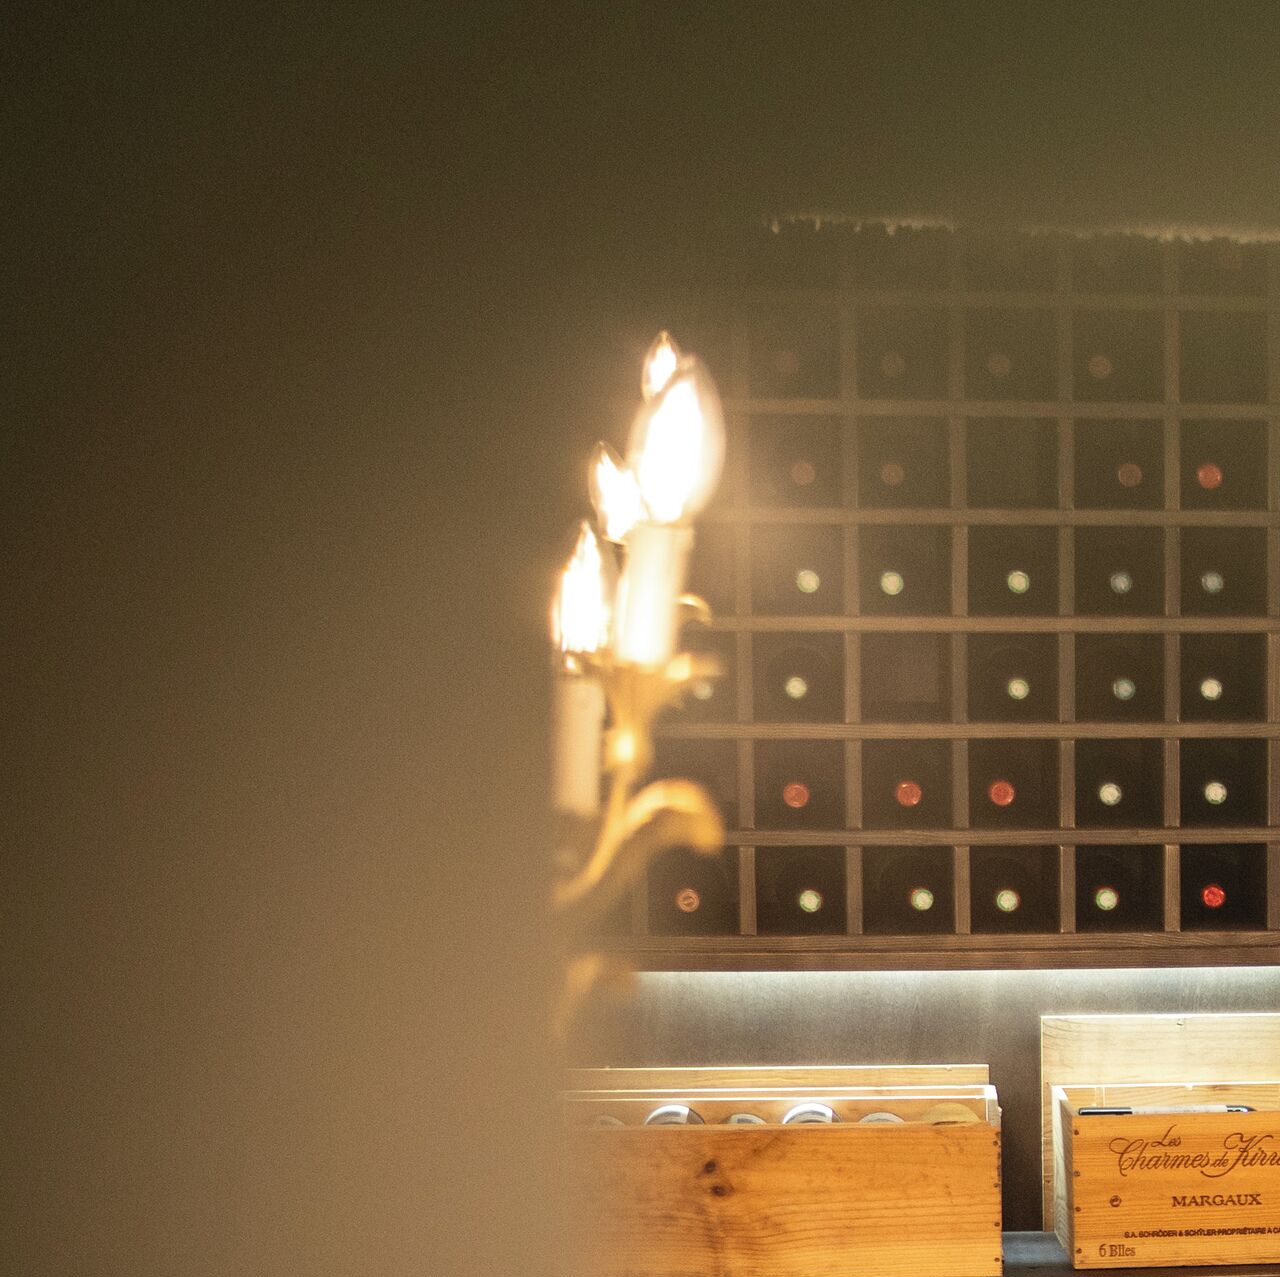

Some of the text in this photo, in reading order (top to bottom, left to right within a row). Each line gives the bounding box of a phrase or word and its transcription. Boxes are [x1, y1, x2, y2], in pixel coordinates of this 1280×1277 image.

[1152, 1125, 1181, 1148] Les
[1109, 1138, 1210, 1176] Charmes
[1212, 1152, 1229, 1167] de
[1172, 1194, 1263, 1208] MARGAUX
[1099, 1243, 1107, 1257] 6
